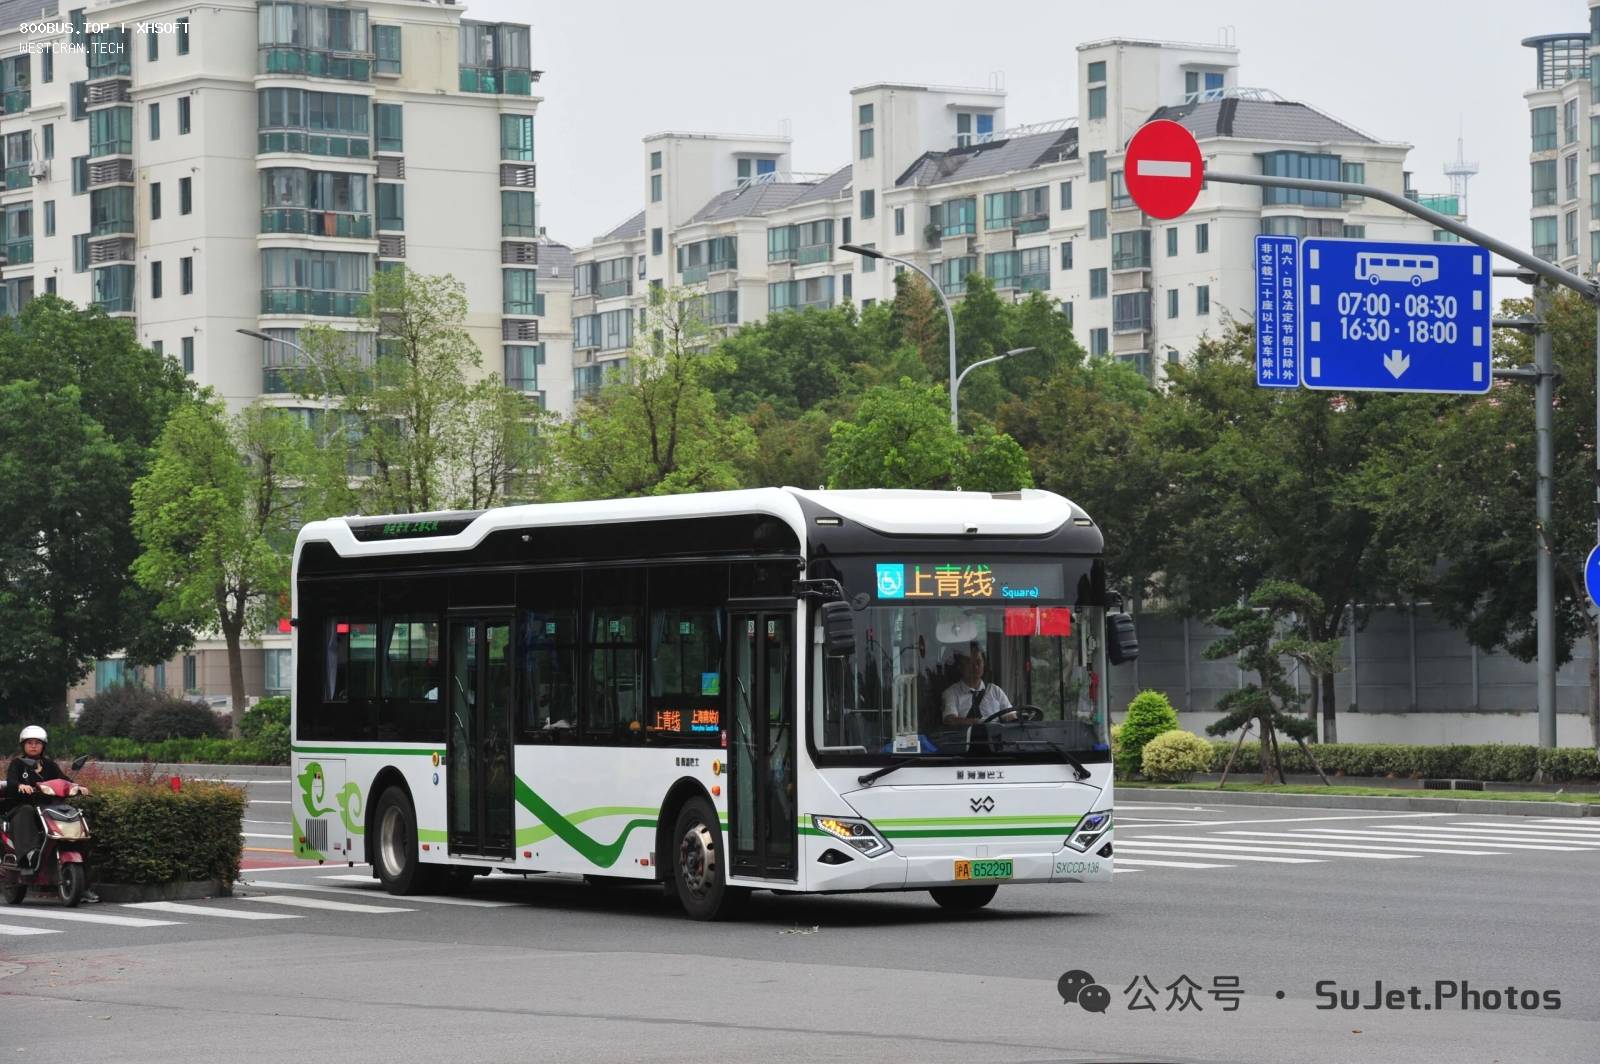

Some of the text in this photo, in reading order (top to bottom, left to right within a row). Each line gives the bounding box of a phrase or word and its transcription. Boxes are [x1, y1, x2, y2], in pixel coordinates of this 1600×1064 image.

[1260, 243, 1274, 380] 非空载二十座以上客车除外
[1281, 244, 1294, 380] 周六、日及法定节假日除外
[1337, 292, 1391, 317] 07:00
[1404, 294, 1458, 319] 08:30
[1340, 316, 1391, 342] 16:30
[1407, 319, 1458, 344] 18:00
[905, 564, 993, 597] 上青线
[1001, 586, 1040, 599] Square)
[655, 710, 681, 732] 上青线
